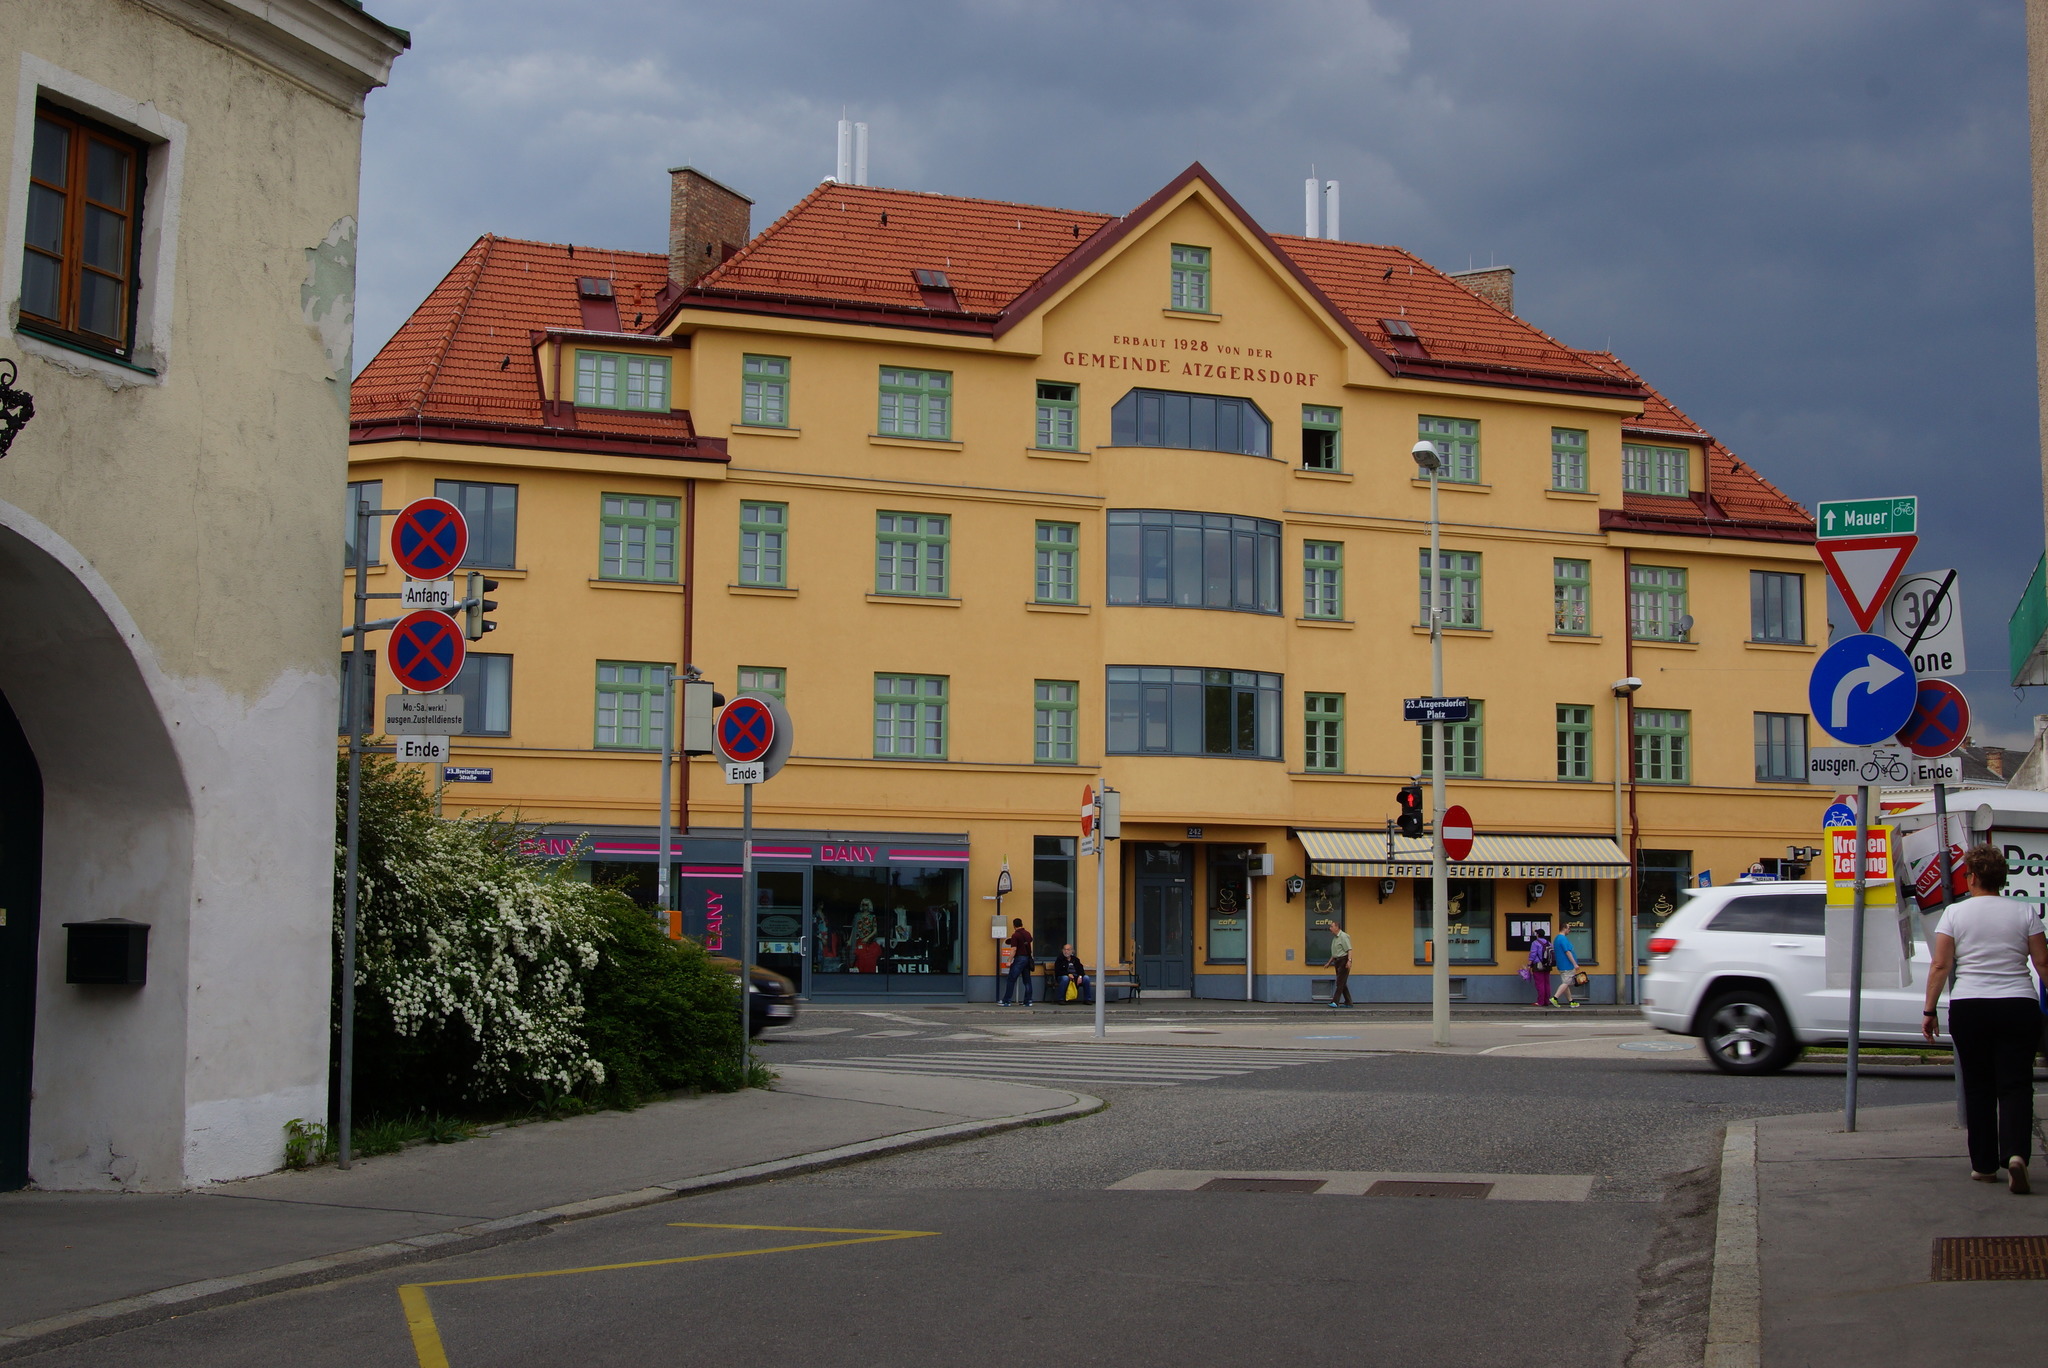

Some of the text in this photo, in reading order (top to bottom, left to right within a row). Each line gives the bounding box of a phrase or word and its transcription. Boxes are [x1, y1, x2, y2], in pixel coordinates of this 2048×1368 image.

[1113, 335, 1273, 358] ERBAUT 1928 VON DER
[1063, 351, 1319, 387] GEMEINDE ATZGERSDORF
[1844, 510, 1888, 526] Mauer
[406, 588, 448, 605] Anfang
[1902, 589, 1941, 629] 30
[1913, 651, 1953, 673] one
[1419, 699, 1466, 710] Atzgersdorfer
[413, 714, 462, 724] Zustelldienste
[1426, 709, 1446, 719] Platz
[405, 741, 440, 757] Ende
[732, 767, 757, 780] Ende
[1811, 758, 1859, 777] ausgen.
[1918, 763, 1953, 779] Ende
[1188, 827, 1202, 835] 242
[1833, 836, 1886, 854] Kroen
[821, 845, 879, 863] DANY
[1387, 866, 1422, 876] CAFE
[1502, 867, 1510, 877] &
[1520, 867, 1563, 877] LESEN
[1834, 853, 1887, 874] Zeing
[1916, 846, 1962, 891] KURIR
[1447, 923, 1470, 935] afe
